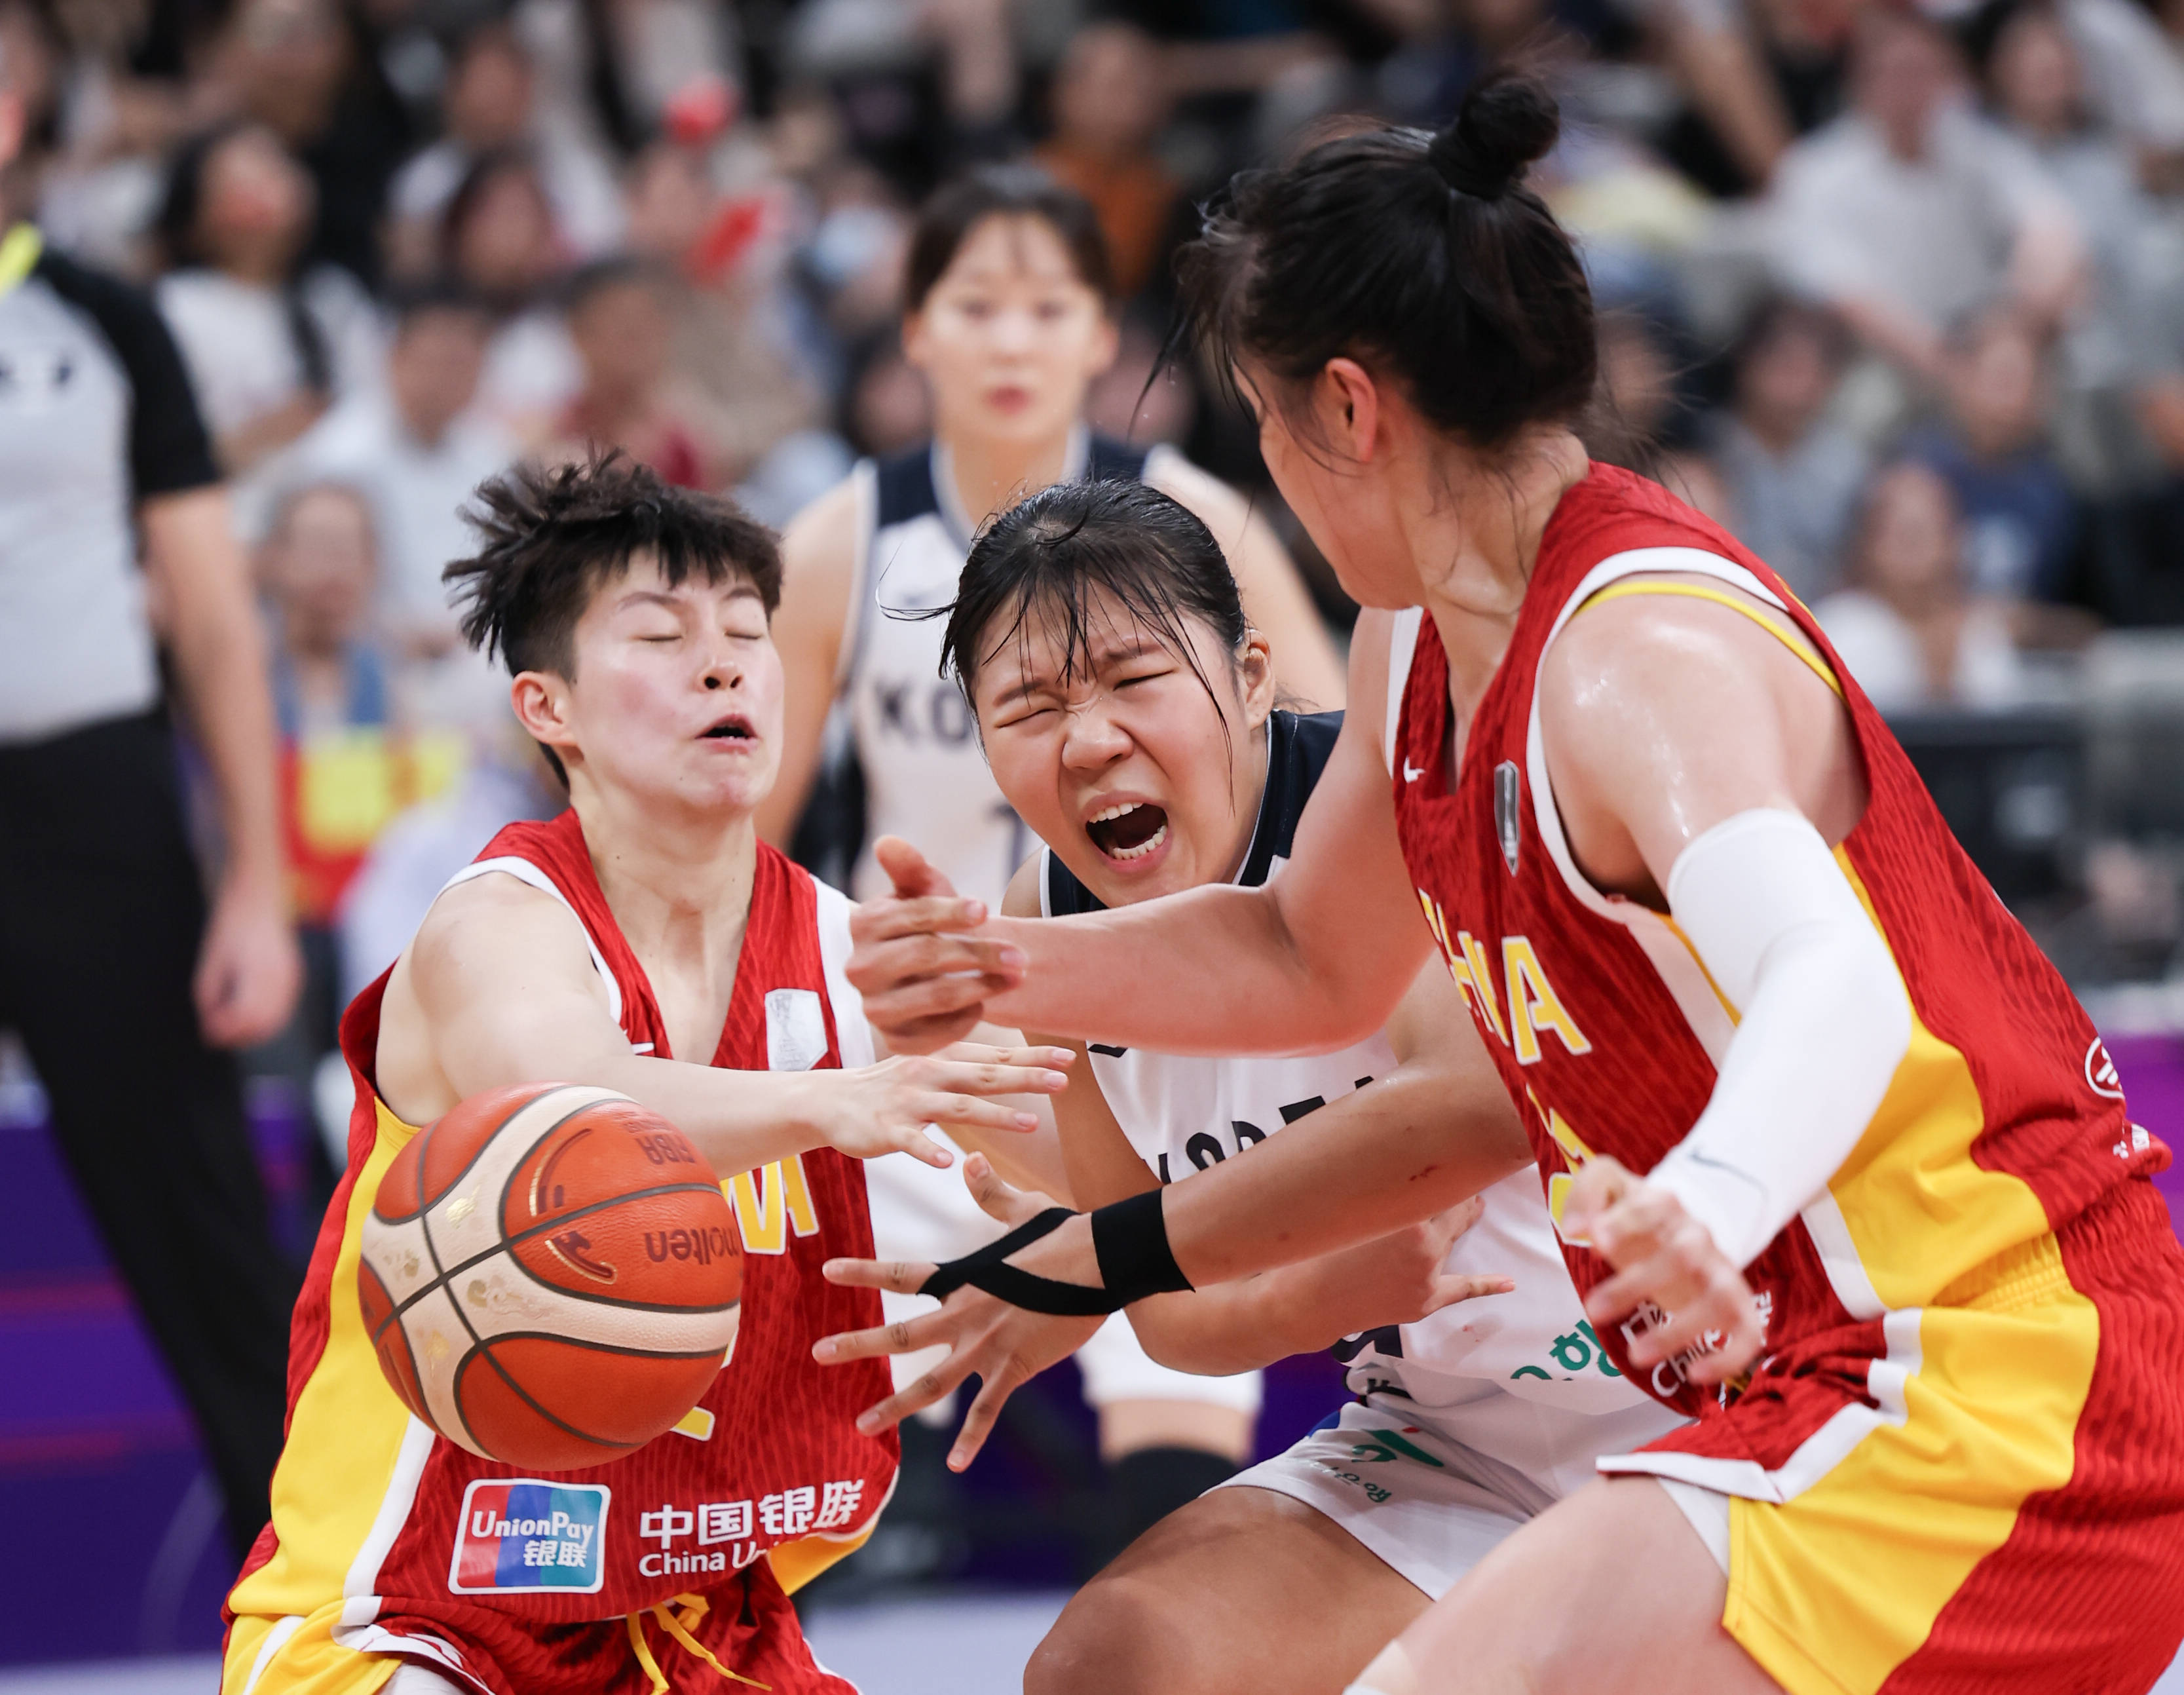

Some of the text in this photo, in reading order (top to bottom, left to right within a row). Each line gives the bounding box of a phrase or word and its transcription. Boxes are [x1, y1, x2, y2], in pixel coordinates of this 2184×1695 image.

[644, 1225, 740, 1265] molten
[471, 1510, 593, 1550] UnionPay
[639, 1479, 865, 1550] 中国银联
[523, 1540, 587, 1568] 银联
[639, 1552, 725, 1577] China
